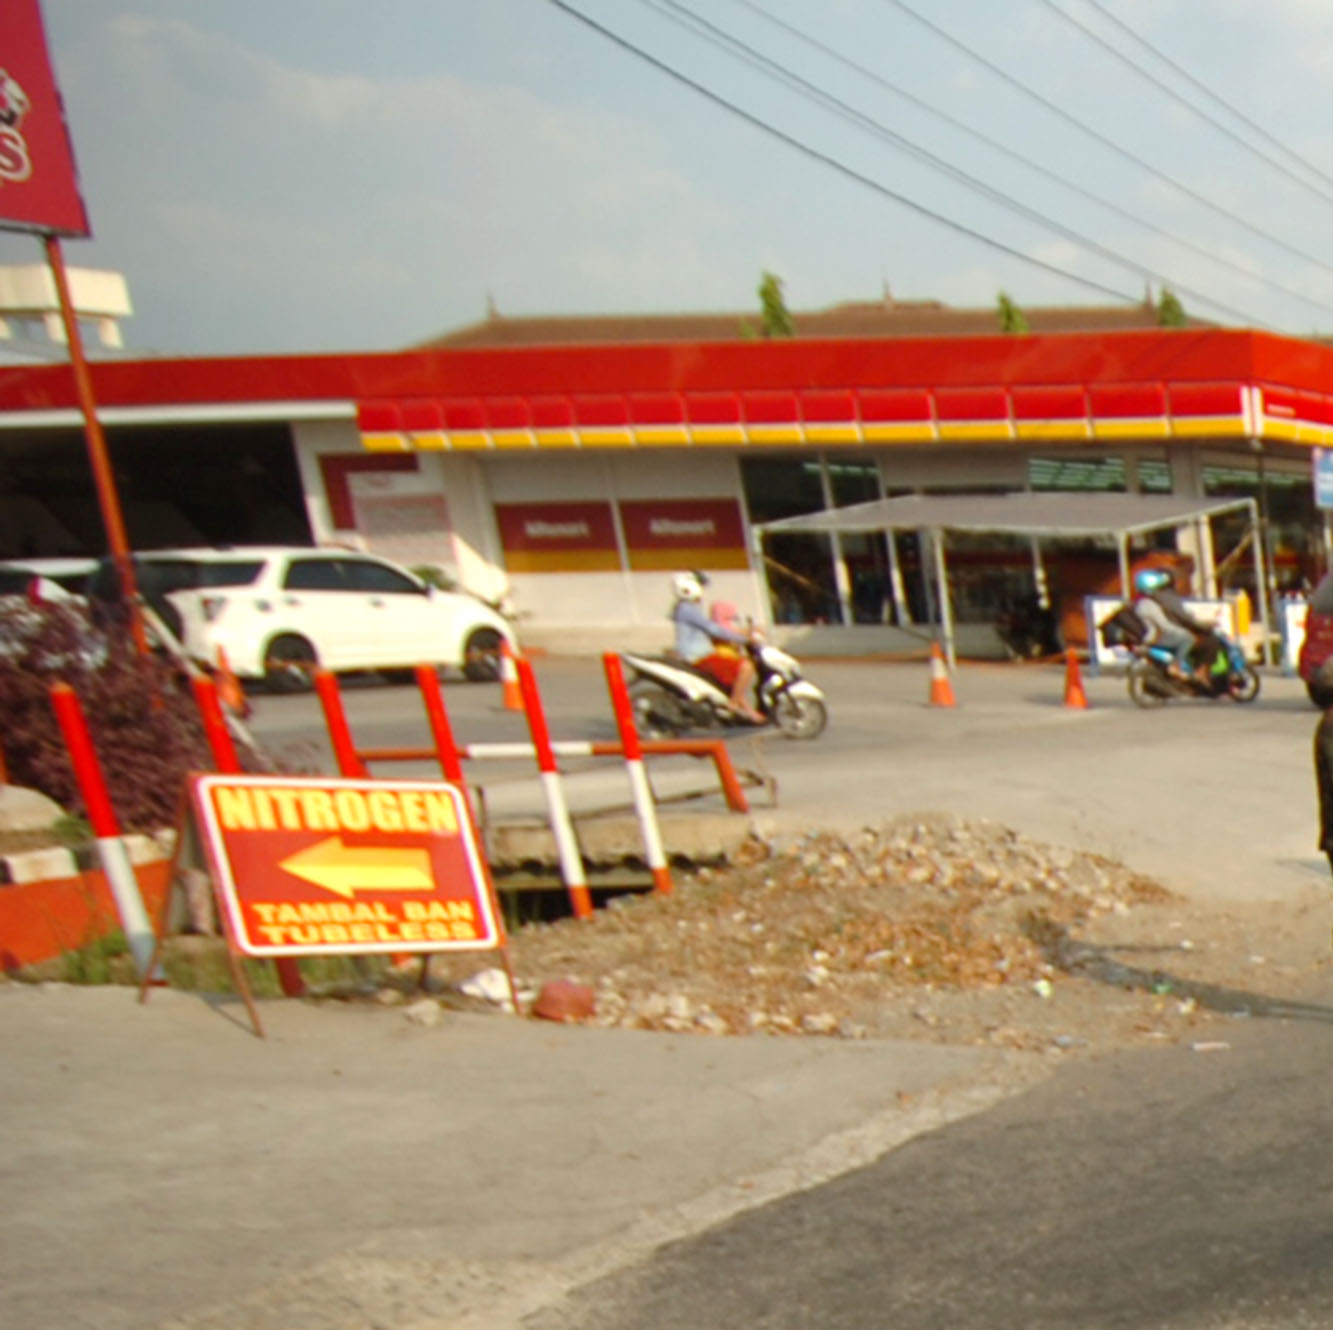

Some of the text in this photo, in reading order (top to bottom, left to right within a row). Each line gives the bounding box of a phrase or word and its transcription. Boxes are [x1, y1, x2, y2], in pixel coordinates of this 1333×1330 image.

[214, 786, 460, 832] NITROGEN
[252, 901, 474, 923] TAMBAL BAN
[257, 922, 477, 944] TUBELESS
